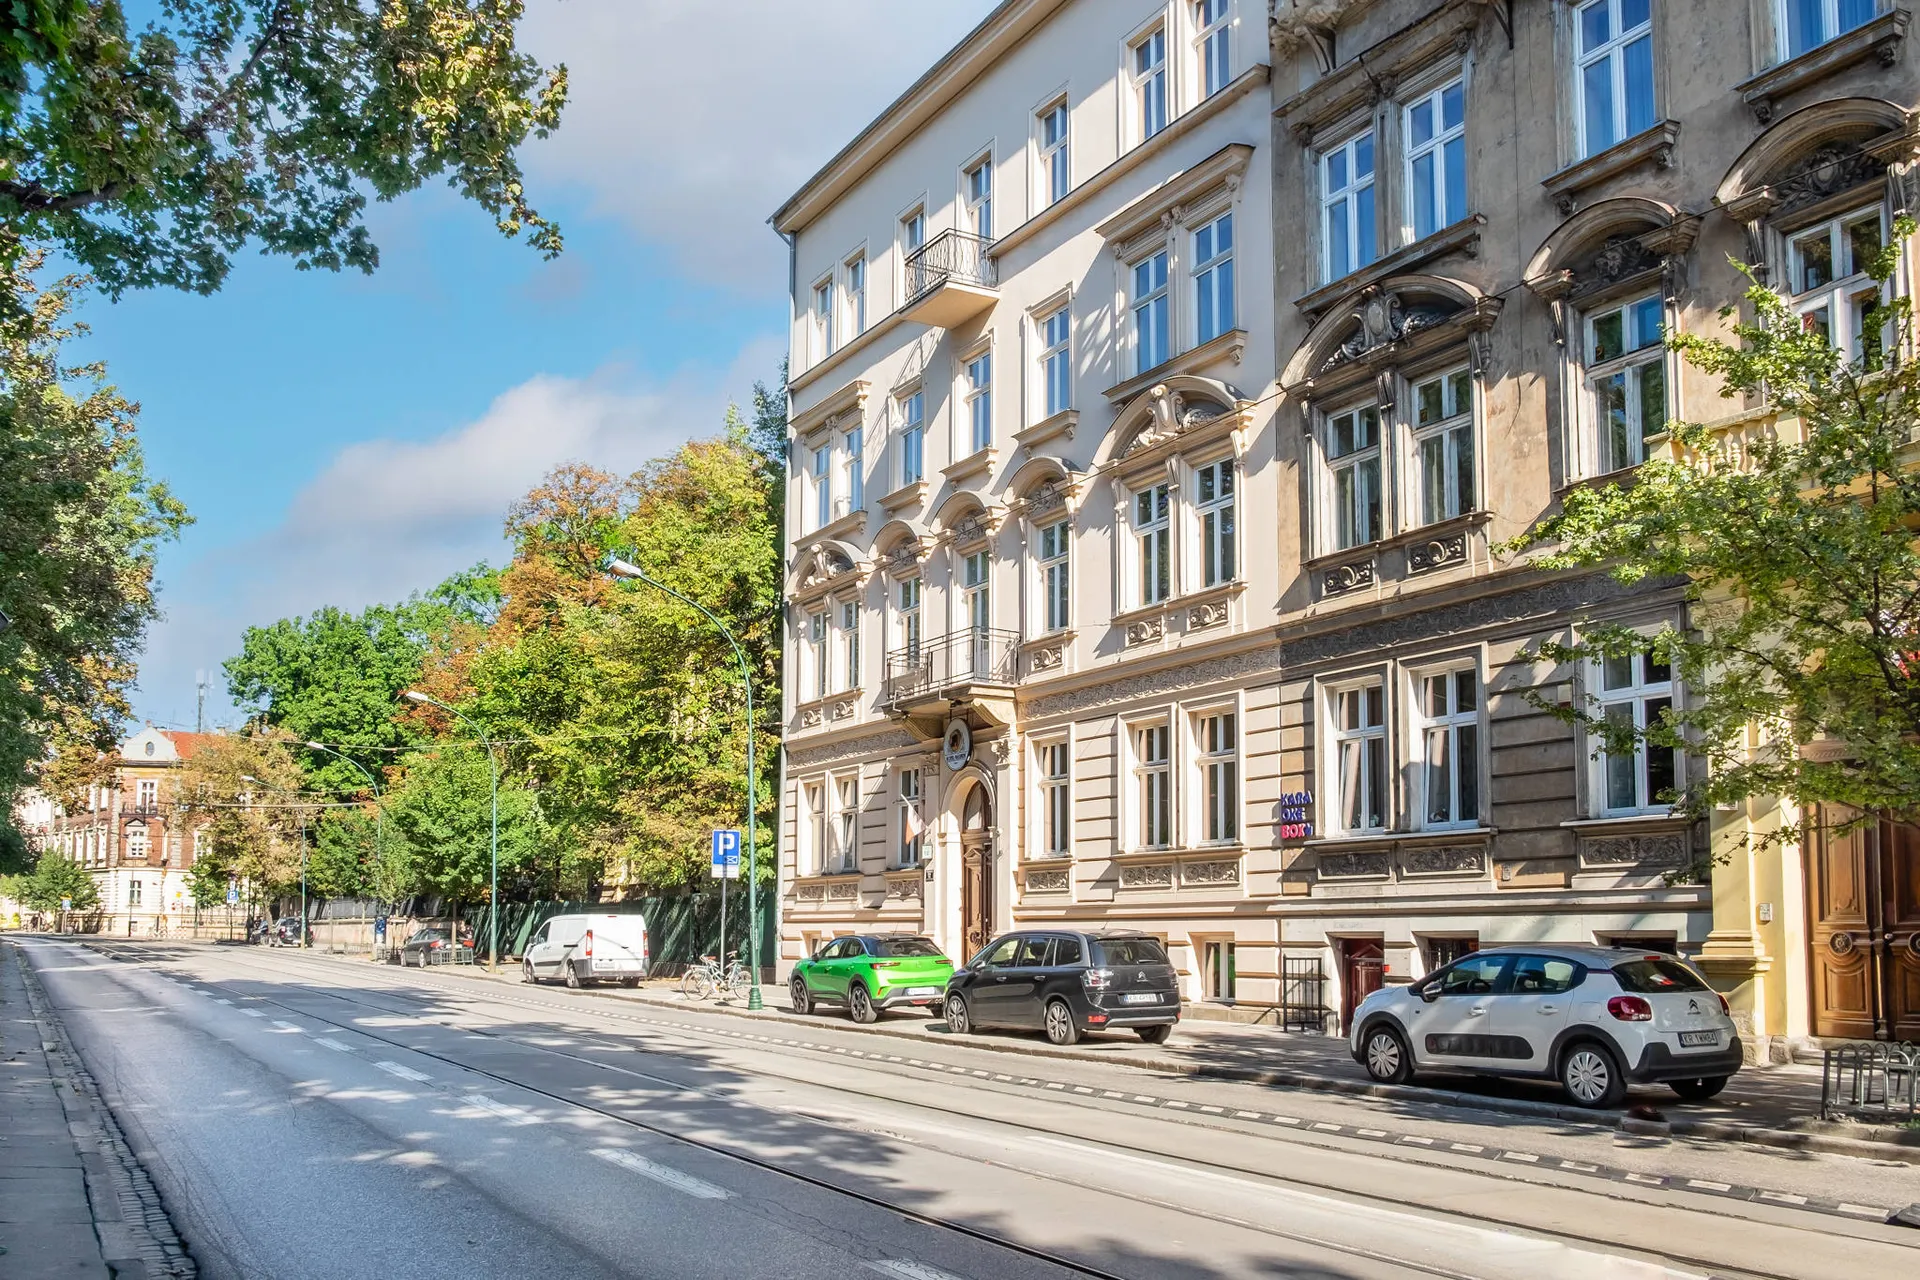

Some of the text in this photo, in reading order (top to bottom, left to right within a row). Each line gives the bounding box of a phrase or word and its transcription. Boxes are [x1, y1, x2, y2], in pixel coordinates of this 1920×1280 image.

[1281, 790, 1313, 806] KARA
[1281, 807, 1306, 821] OKE
[718, 833, 735, 856] P
